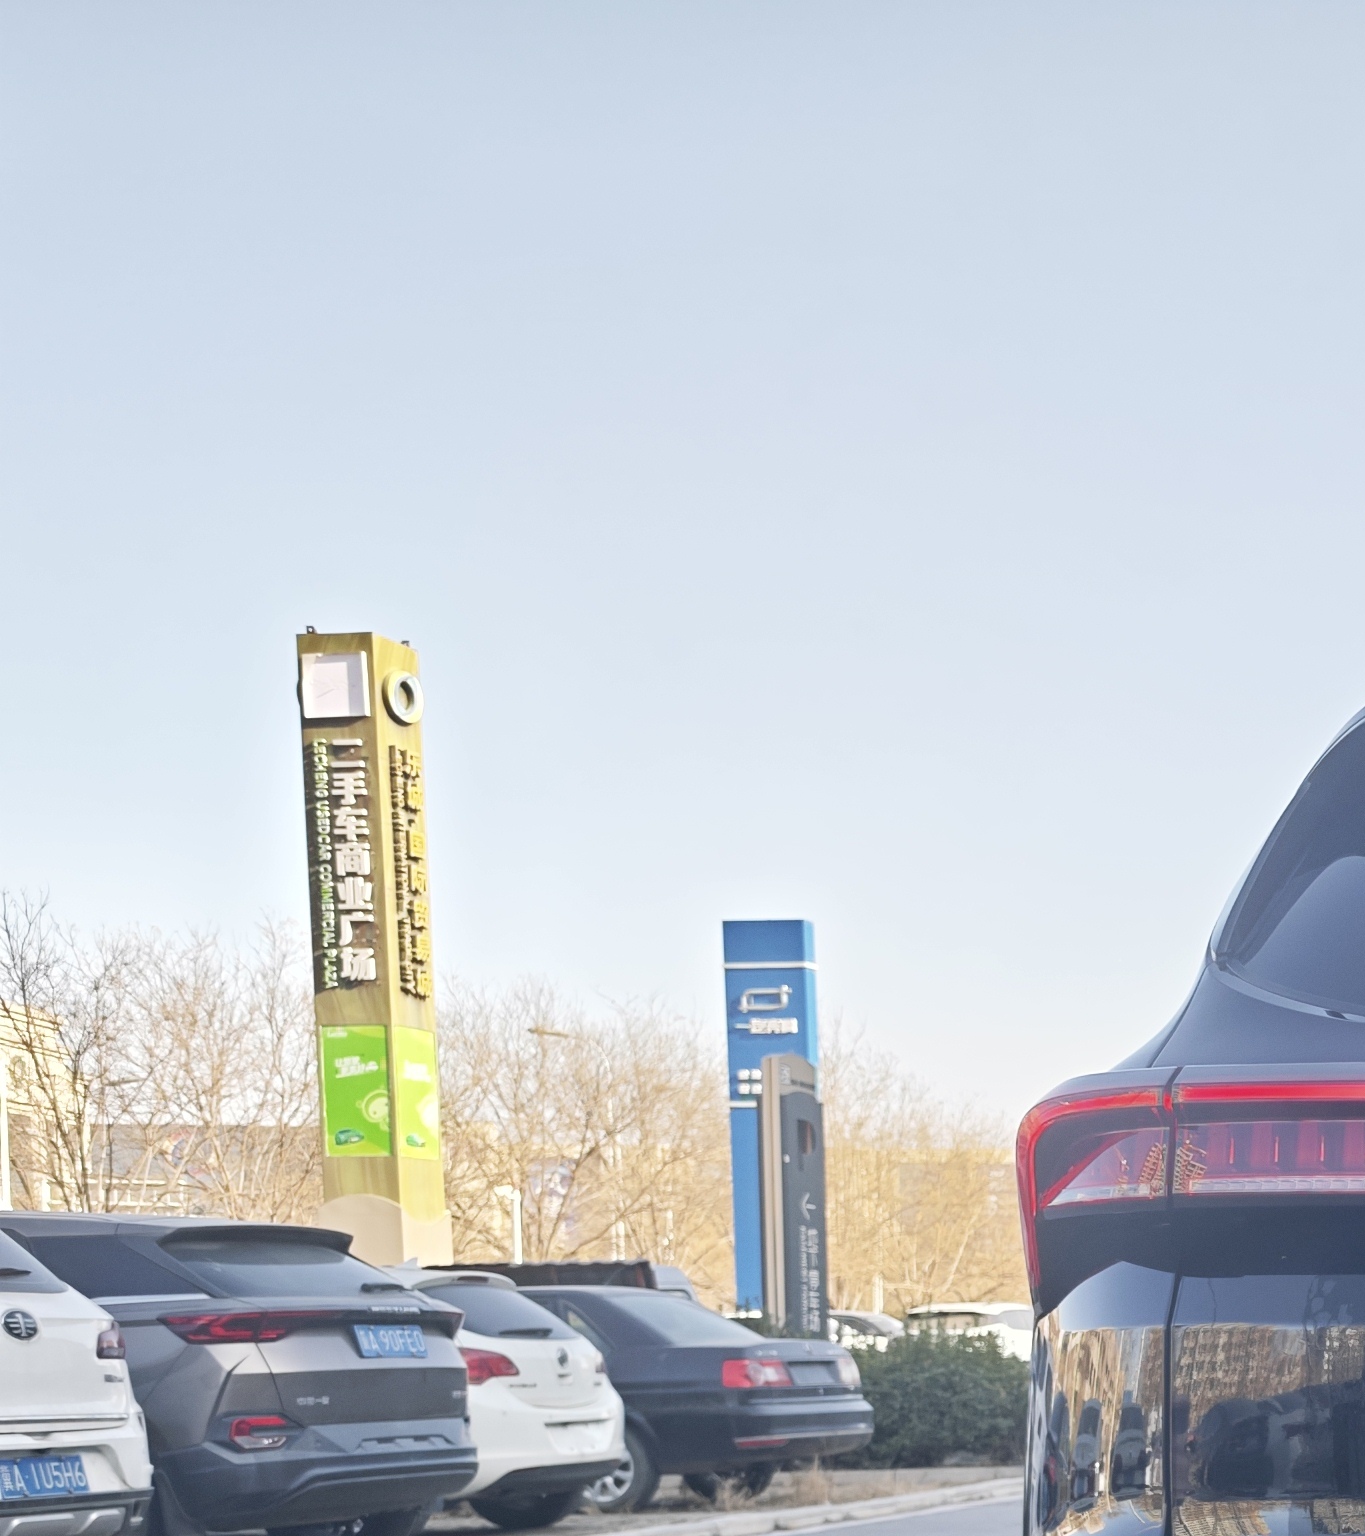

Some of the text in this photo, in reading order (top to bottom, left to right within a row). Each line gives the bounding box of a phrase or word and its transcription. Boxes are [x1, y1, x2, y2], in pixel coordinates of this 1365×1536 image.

[332, 738, 376, 983] 二手车商业广场
[317, 863, 336, 947] COMMERCIAL
[323, 948, 339, 989] PLAZA
